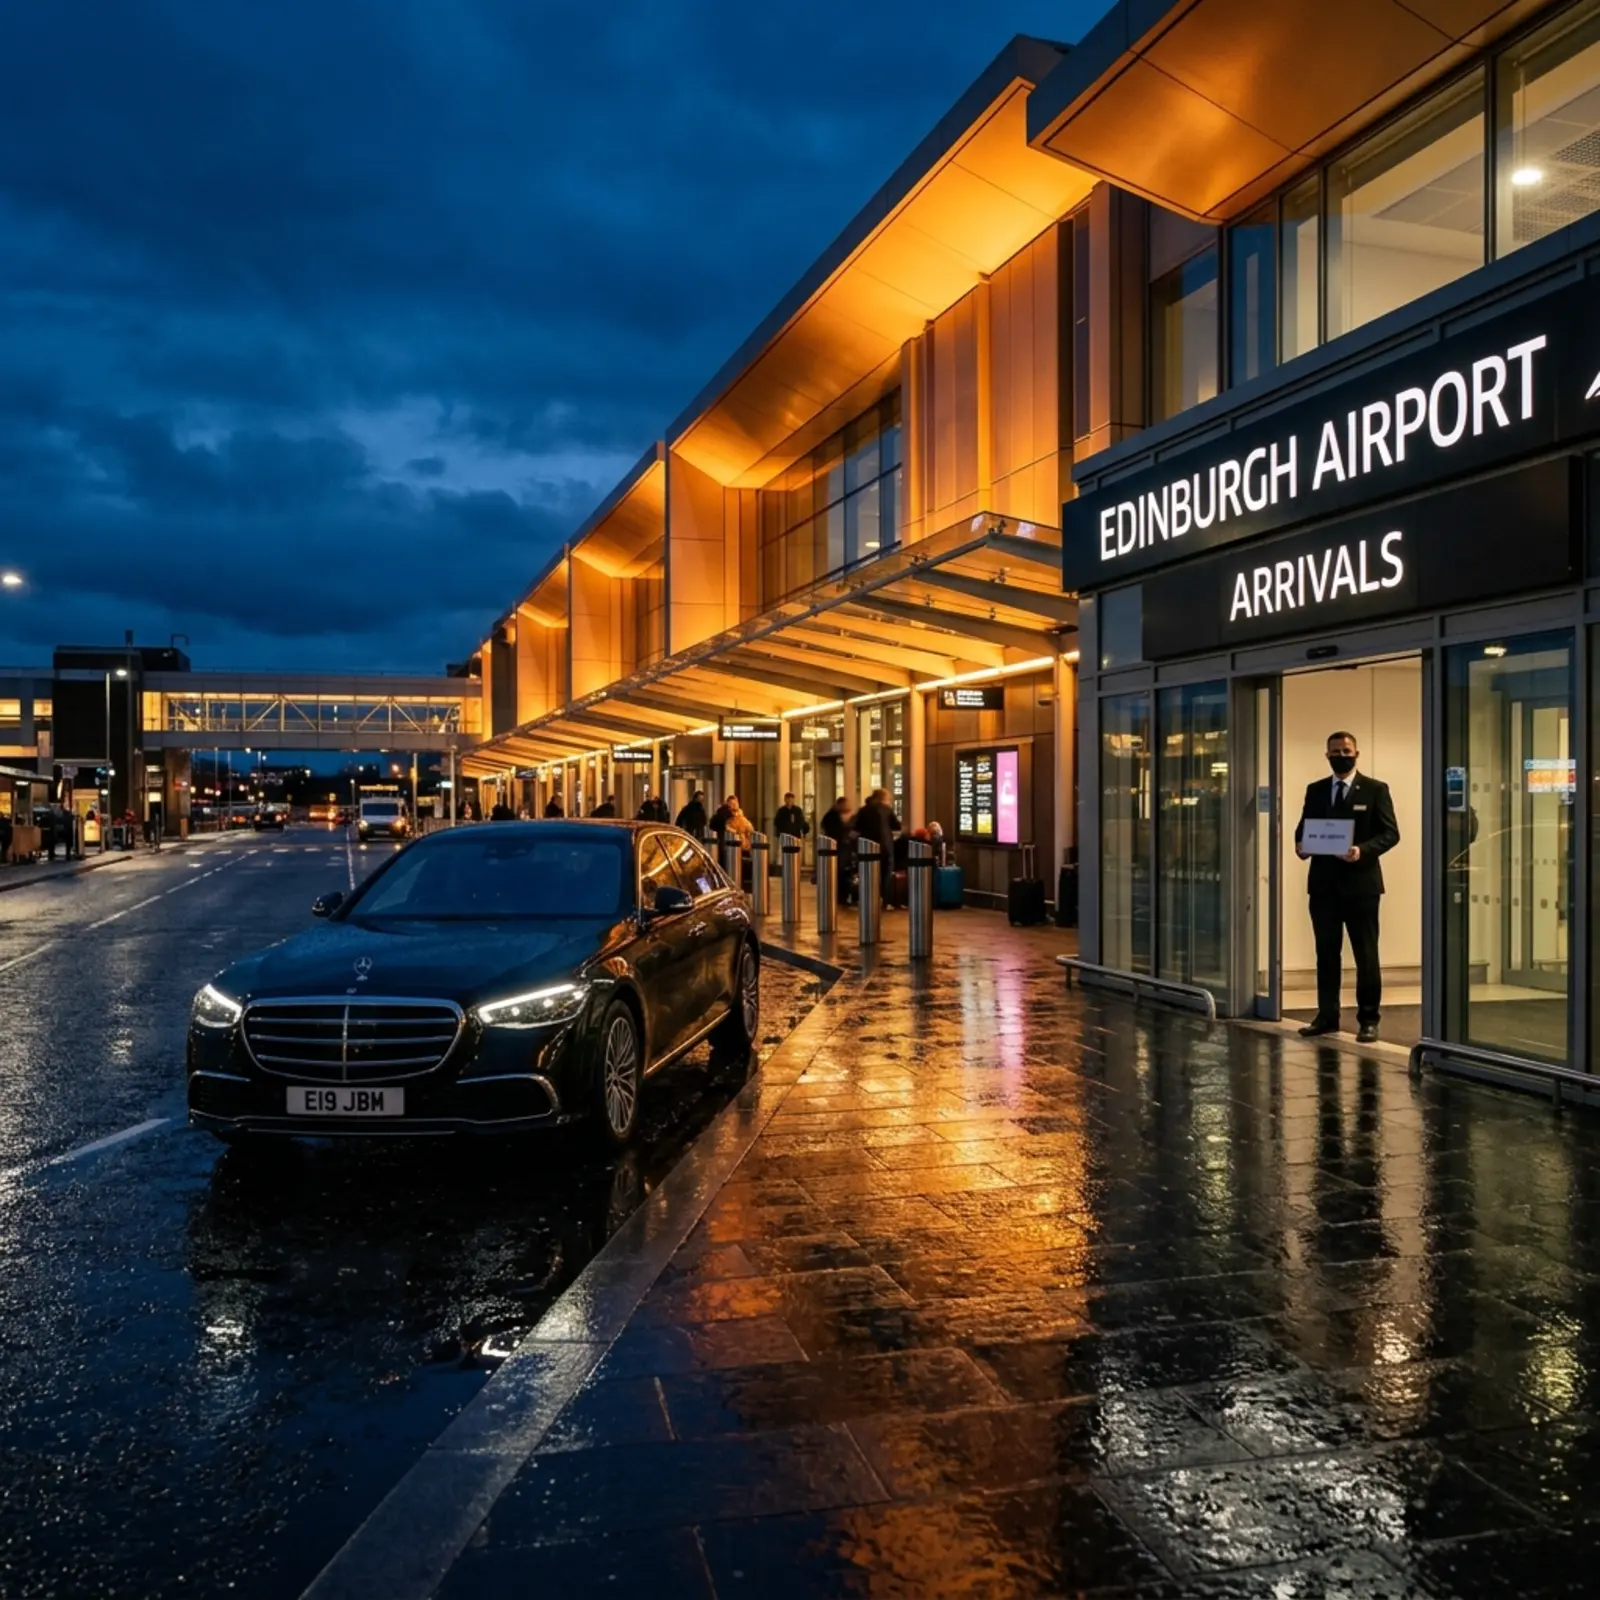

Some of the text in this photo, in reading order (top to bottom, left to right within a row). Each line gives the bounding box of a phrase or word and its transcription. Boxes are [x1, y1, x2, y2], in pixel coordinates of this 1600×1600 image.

[1100, 334, 1547, 561] EDINBURGH AIRPORT
[1229, 530, 1405, 622] ARRIVALS
[304, 1090, 384, 1112] E19 JBM
